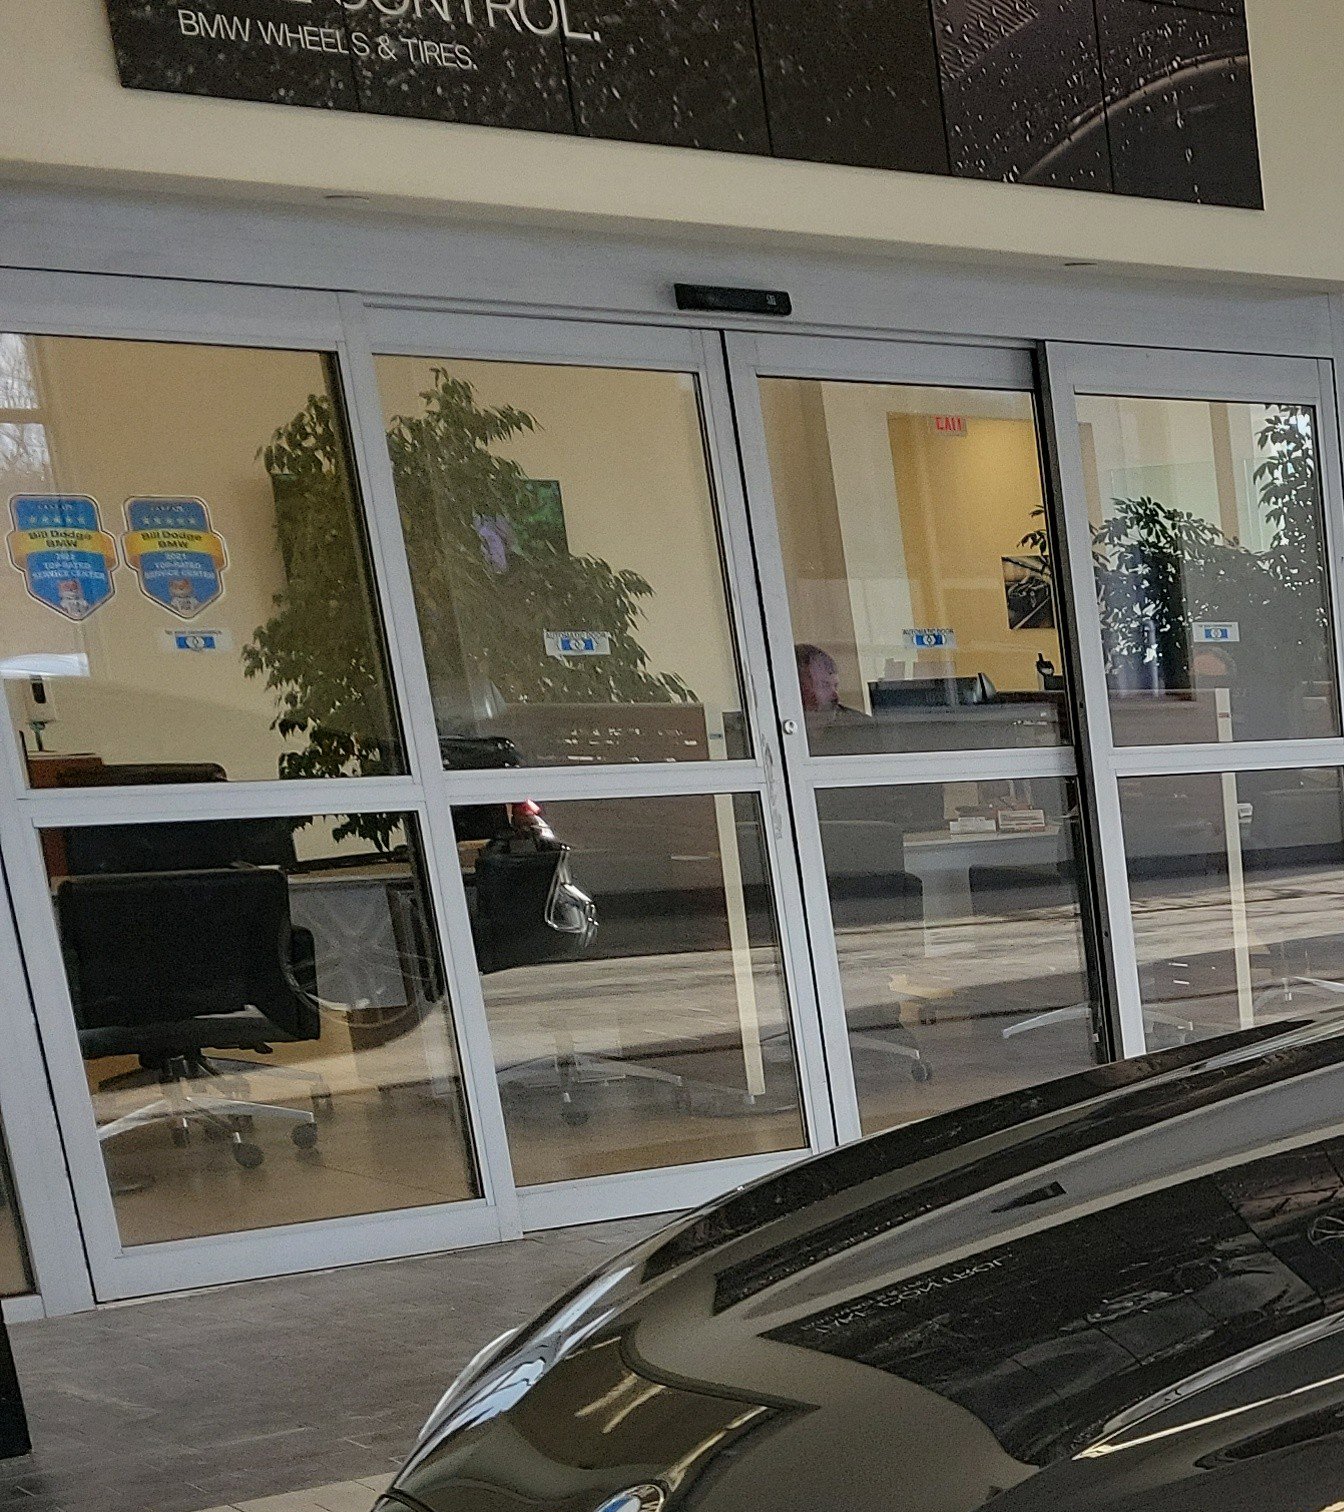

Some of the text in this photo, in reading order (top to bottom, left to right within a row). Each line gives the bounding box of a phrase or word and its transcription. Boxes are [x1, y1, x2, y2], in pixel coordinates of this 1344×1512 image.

[178, 9, 478, 71] BMW WHEELS & TIRES.
[141, 530, 202, 542] Bill Dodge
